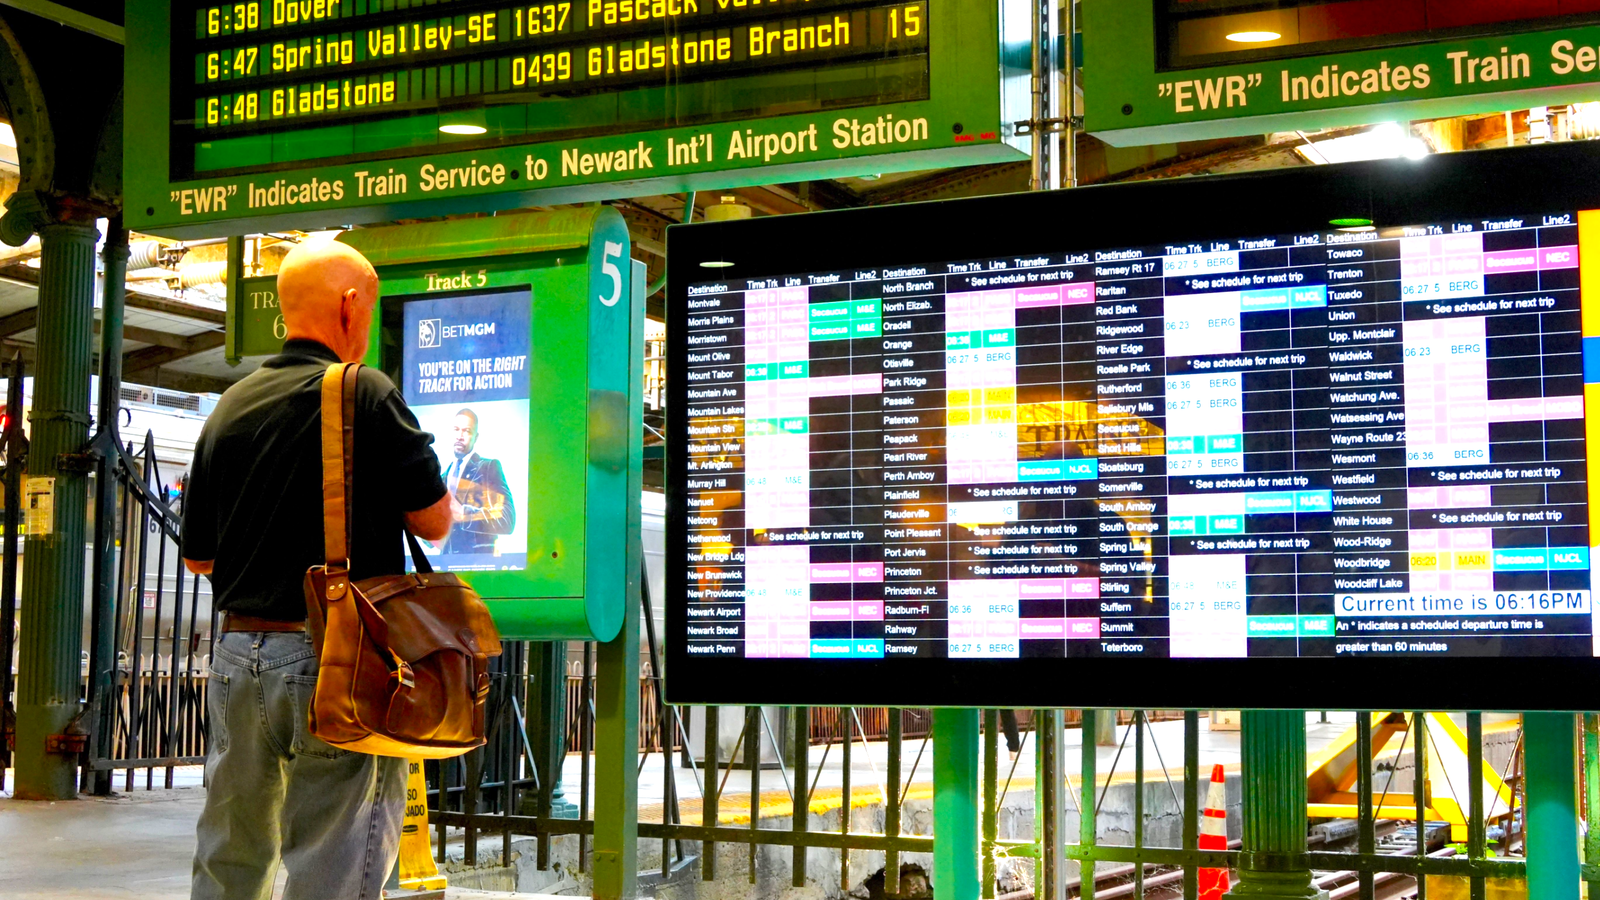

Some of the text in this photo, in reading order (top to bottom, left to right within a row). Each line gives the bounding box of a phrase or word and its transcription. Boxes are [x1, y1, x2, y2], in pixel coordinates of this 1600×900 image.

[208, 0, 339, 34] 6:38 Dover
[208, 47, 258, 79] 6:47
[272, 38, 352, 72] Spring
[368, 13, 496, 57] Valley-SE
[515, 2, 570, 37] 1637
[207, 6, 920, 124] 6:48 Gladstone 0439 Gladstone Branch 15
[1281, 61, 1430, 102] Indicates
[1447, 47, 1530, 84] Train
[1551, 40, 1600, 74] Se
[249, 177, 344, 208] Indicates
[354, 168, 406, 197] Train
[420, 159, 505, 191] Service
[525, 154, 548, 180] to
[562, 141, 653, 177] Newark
[668, 134, 712, 166] Int'l
[727, 124, 818, 162] Airport
[832, 116, 928, 148] Station
[1327, 230, 1378, 244] Destination
[1428, 226, 1443, 235] Trk
[1452, 223, 1473, 234] Line
[1482, 219, 1524, 230] Transfer
[1543, 214, 1571, 225] Line2
[1326, 248, 1363, 260] Towaco
[599, 241, 623, 307] 5
[1095, 266, 1130, 276] Ramsey
[1144, 262, 1155, 272] 17
[1328, 268, 1363, 280] Trenton
[424, 270, 487, 291] Track 5
[882, 280, 934, 293] North Branch
[1448, 280, 1478, 292] BERG
[1327, 289, 1362, 300] Tuxedo
[688, 298, 720, 308] Montvale
[882, 302, 904, 312] North
[1095, 304, 1138, 316] Red Bank
[1328, 310, 1355, 321] Union
[273, 313, 288, 340] 6
[688, 315, 734, 326] Morris Plains
[442, 322, 495, 338] BETMGM
[1096, 323, 1143, 336] Ridgewood
[1328, 328, 1395, 343] Upp. Montclair
[687, 335, 727, 344] Morristown
[882, 340, 912, 350] Orange
[1096, 343, 1143, 355] River Edge
[687, 352, 730, 362] Mount Olive
[1329, 350, 1372, 362] Waldwick
[418, 355, 527, 378] YOU'RE ON THE RIGHT
[687, 370, 734, 380] Mount Tabor
[1329, 370, 1392, 382] Walnut Street
[418, 372, 513, 394] TRACK FOR ACTION
[883, 377, 902, 387] Park
[903, 376, 926, 387] Ridge
[687, 388, 737, 398] Mountain Ave
[1097, 382, 1142, 394] Rutherford
[1330, 390, 1400, 403] Watchung Ave.
[883, 415, 919, 425] Paterson
[1330, 411, 1404, 423] Watsessing Ave
[1331, 434, 1363, 445] Wayne
[1365, 432, 1394, 442] Route
[906, 452, 928, 461] River
[1331, 453, 1376, 464] Wesmont
[1454, 449, 1484, 459] BERG
[883, 470, 935, 481] Perth Amboy
[1332, 474, 1375, 484] Westfield
[1437, 472, 1457, 480] See
[1459, 469, 1503, 480] schedule
[1504, 468, 1519, 478] for
[1520, 467, 1542, 478] next
[1544, 466, 1560, 478] trip
[687, 478, 726, 489] Murray Hill
[1098, 481, 1143, 492] Somerville
[1332, 494, 1381, 505] Westwood
[1333, 515, 1393, 526] White House
[1333, 536, 1391, 548] Wood-Ridge
[884, 547, 926, 557] Port Jervis
[1333, 557, 1390, 569] Woodbridge
[884, 567, 922, 576] Princeton
[1334, 578, 1378, 588] Woodcliff
[1379, 578, 1403, 588] Lake
[884, 586, 938, 595] Princeton Jct.
[1342, 592, 1583, 612] Current time is 06:16PM
[687, 607, 741, 618] Newark Airport
[885, 624, 917, 635] Rahway
[1100, 622, 1133, 632] Summit
[1335, 621, 1349, 630] An
[1357, 620, 1399, 630] indicates
[1401, 622, 1408, 630] a
[1410, 619, 1459, 630] scheduled
[1461, 619, 1508, 631] departure
[1510, 619, 1532, 629] time
[1534, 619, 1544, 629] is
[687, 644, 736, 653] Newark Penn
[885, 644, 918, 654] Ramsey
[1100, 642, 1143, 652] Teterboro
[1335, 641, 1447, 653] greater than 60 minutes
